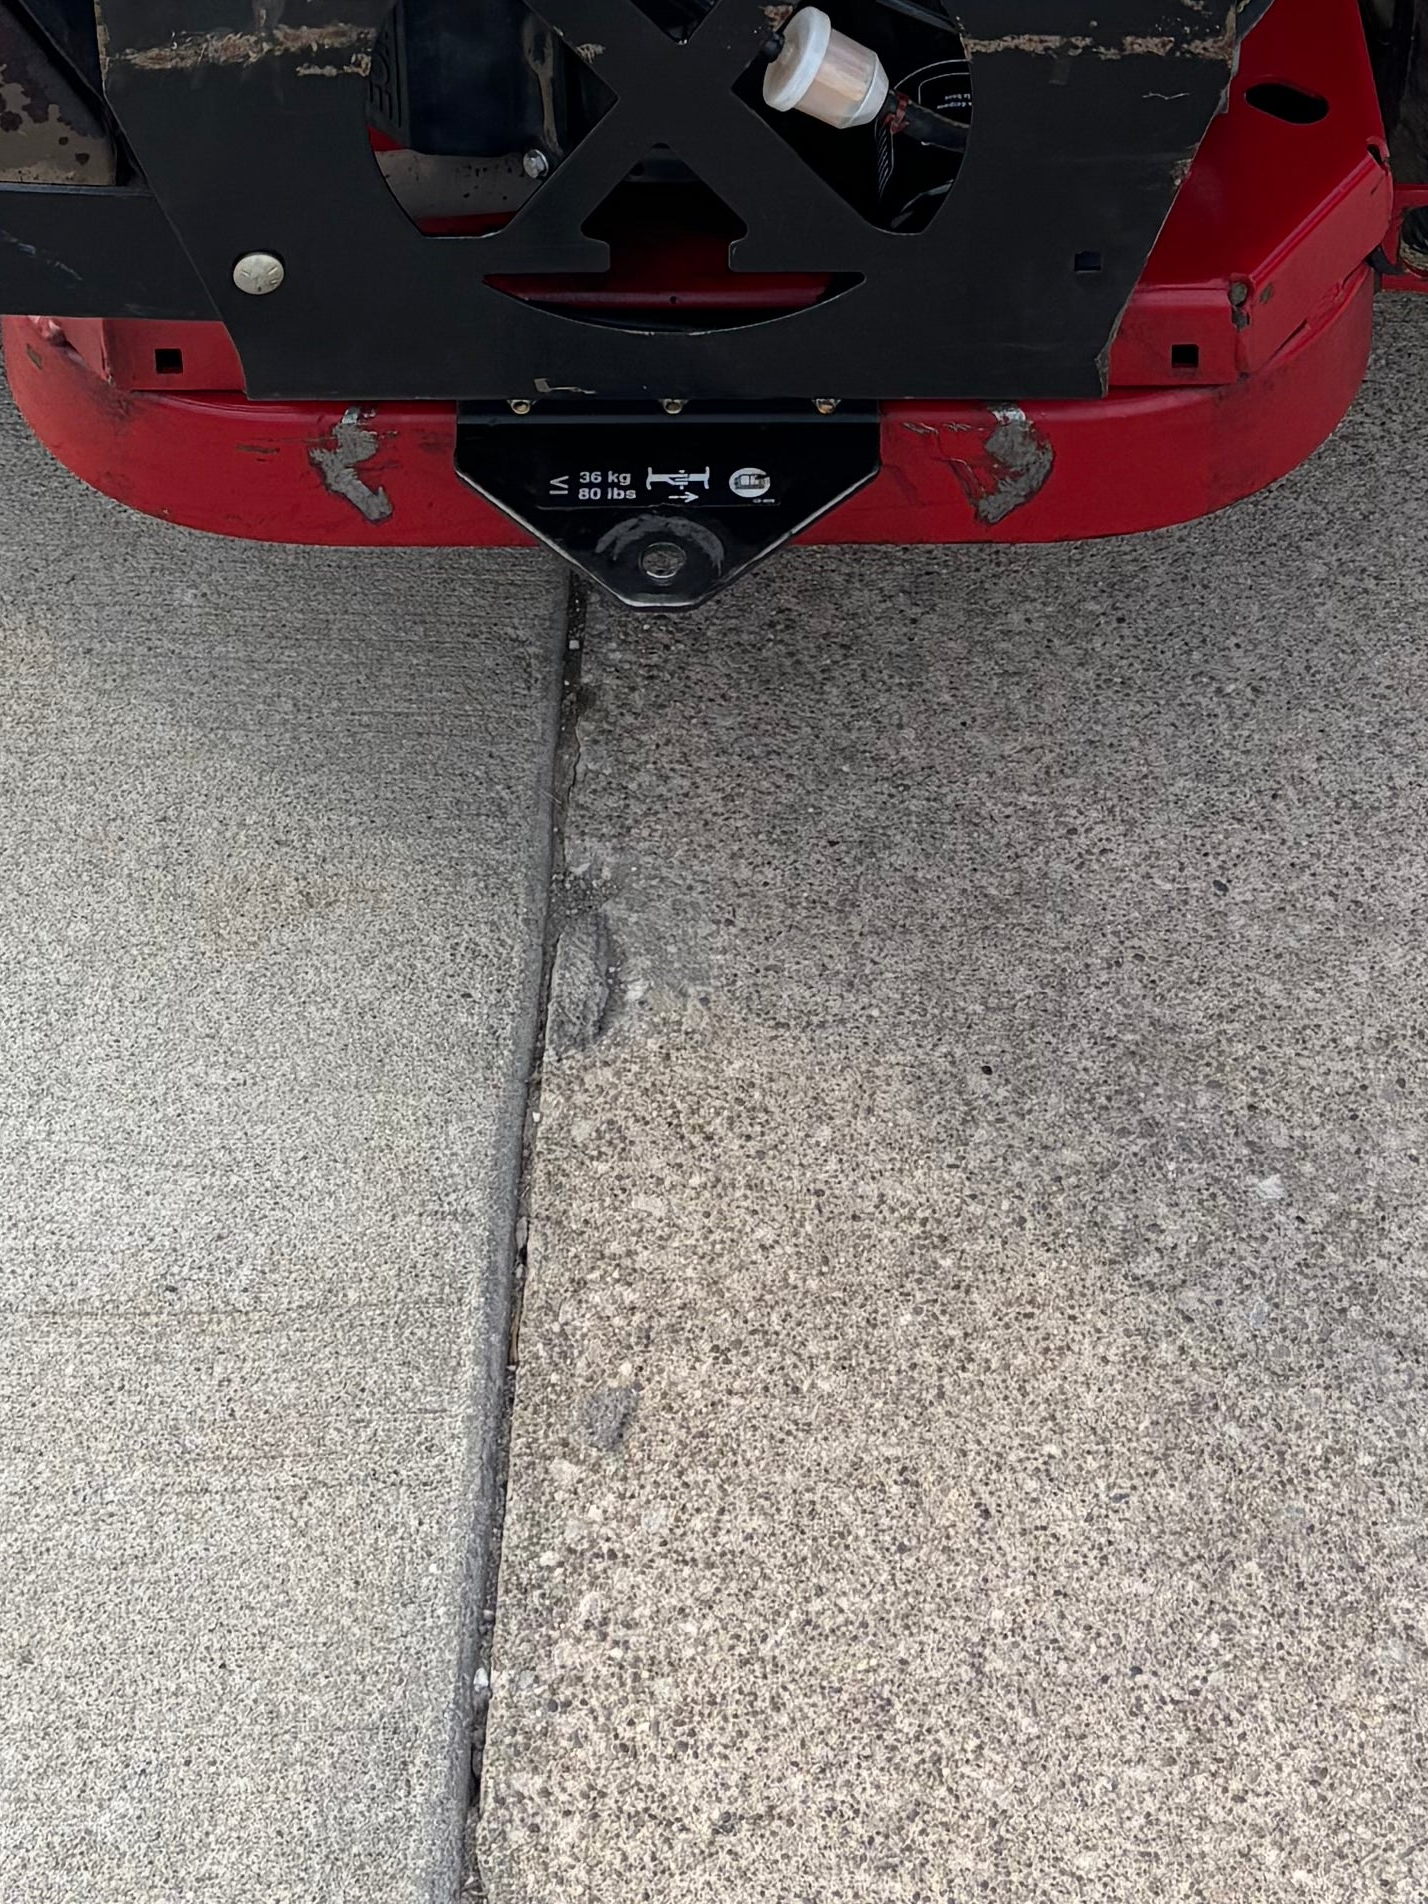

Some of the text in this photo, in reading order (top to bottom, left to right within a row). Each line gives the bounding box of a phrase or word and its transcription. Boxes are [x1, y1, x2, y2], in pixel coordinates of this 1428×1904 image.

[579, 471, 602, 483] 36
[608, 471, 631, 485] kg
[578, 487, 636, 500] 80 lbs
